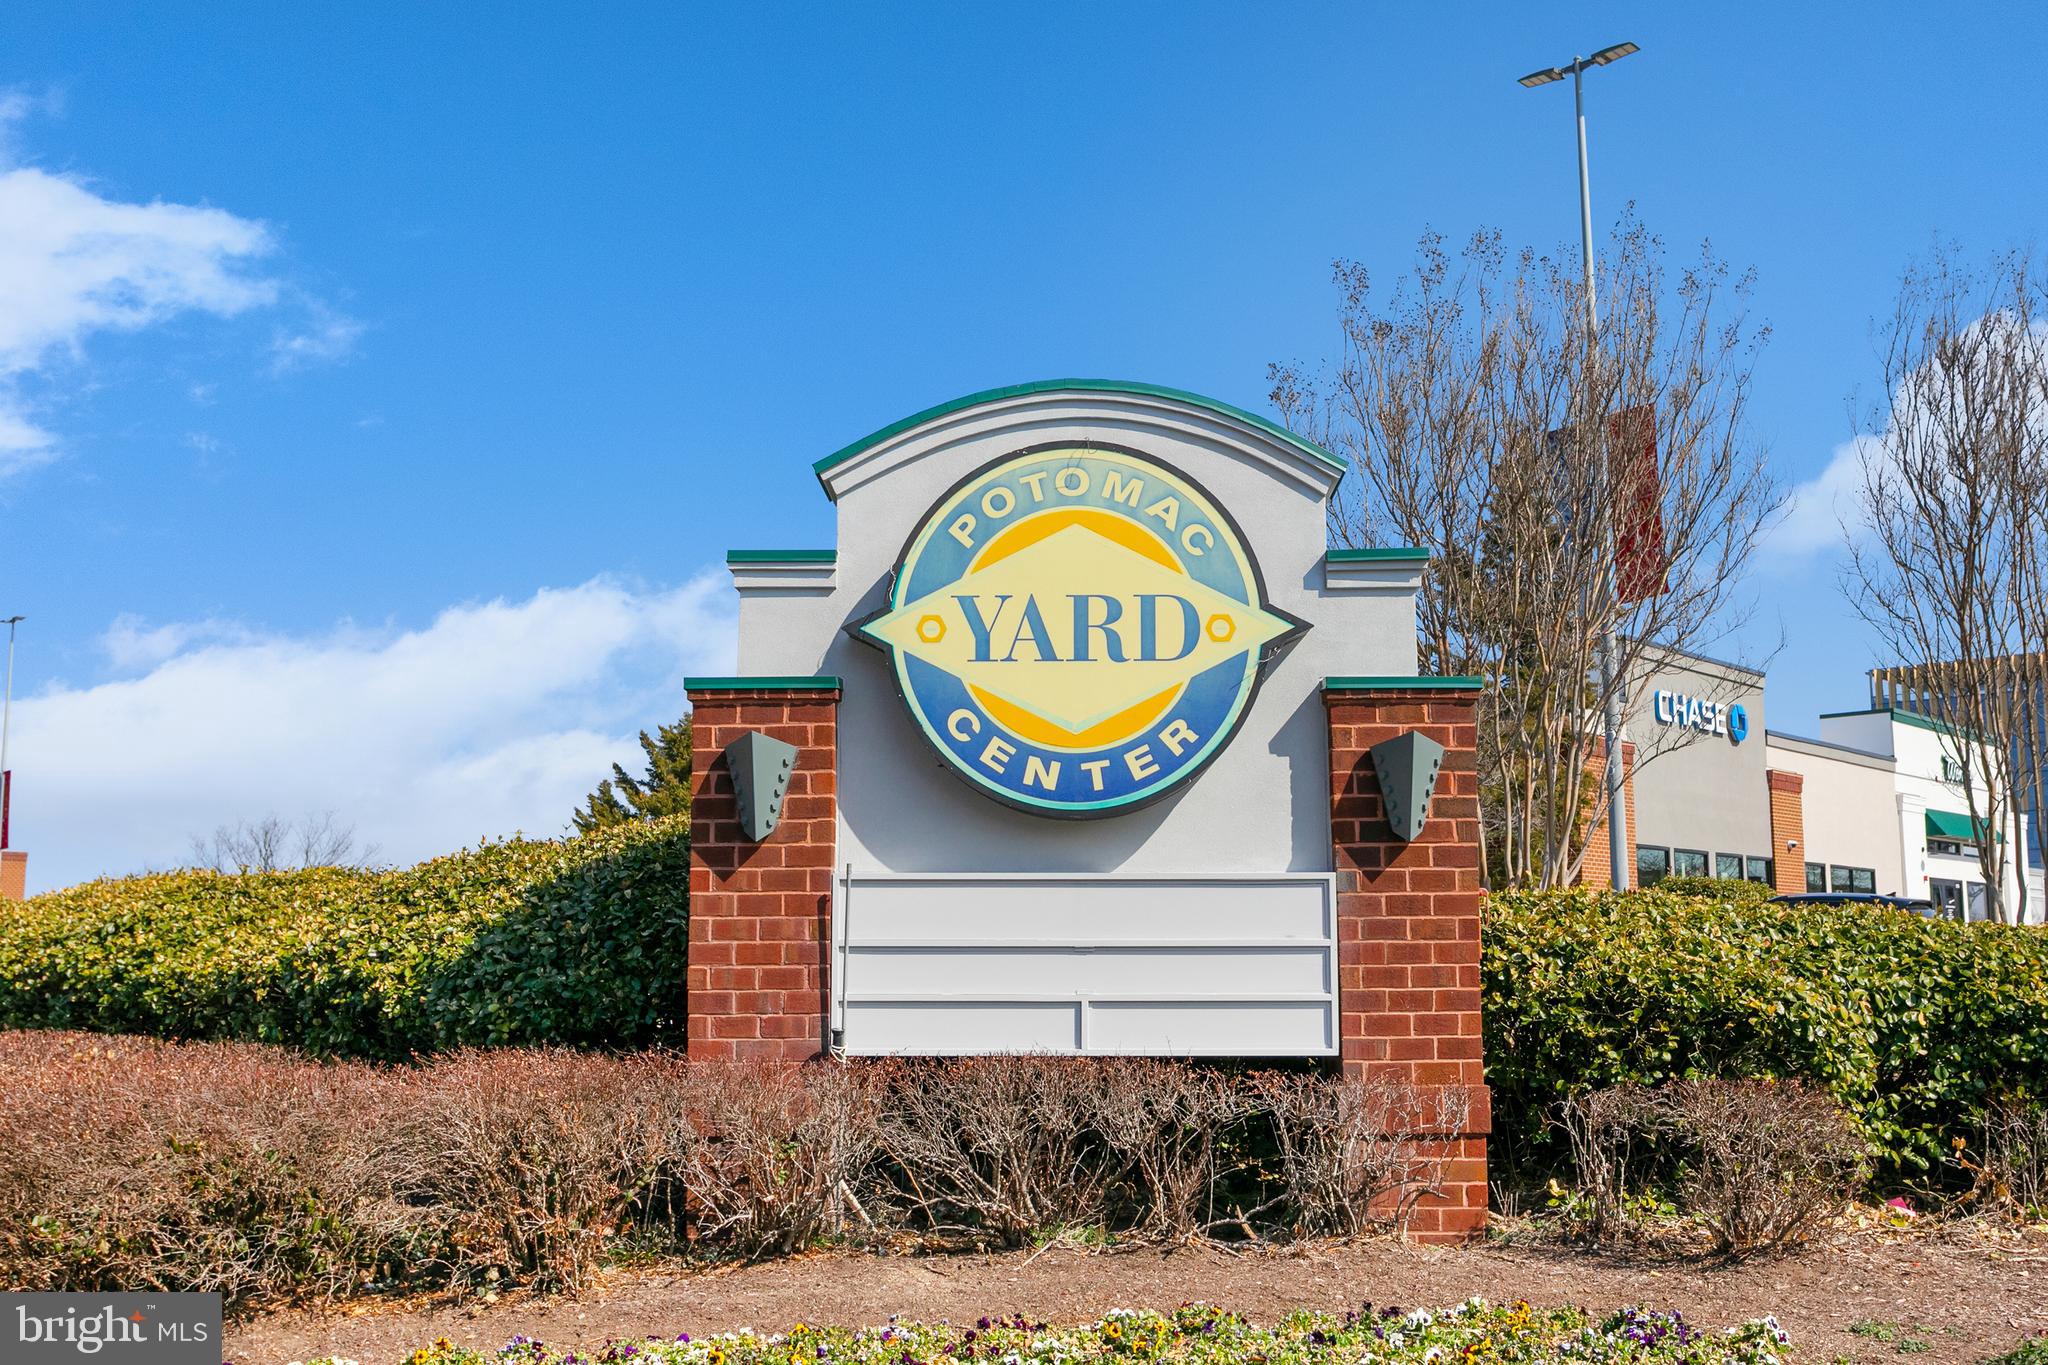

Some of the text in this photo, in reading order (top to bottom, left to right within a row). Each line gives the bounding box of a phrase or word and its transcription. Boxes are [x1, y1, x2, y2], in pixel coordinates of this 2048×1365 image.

[947, 467, 1215, 557] POTOMAC
[951, 593, 1201, 662] YARD
[947, 708, 1199, 791] CENTER
[1654, 689, 1729, 734] CHASE
